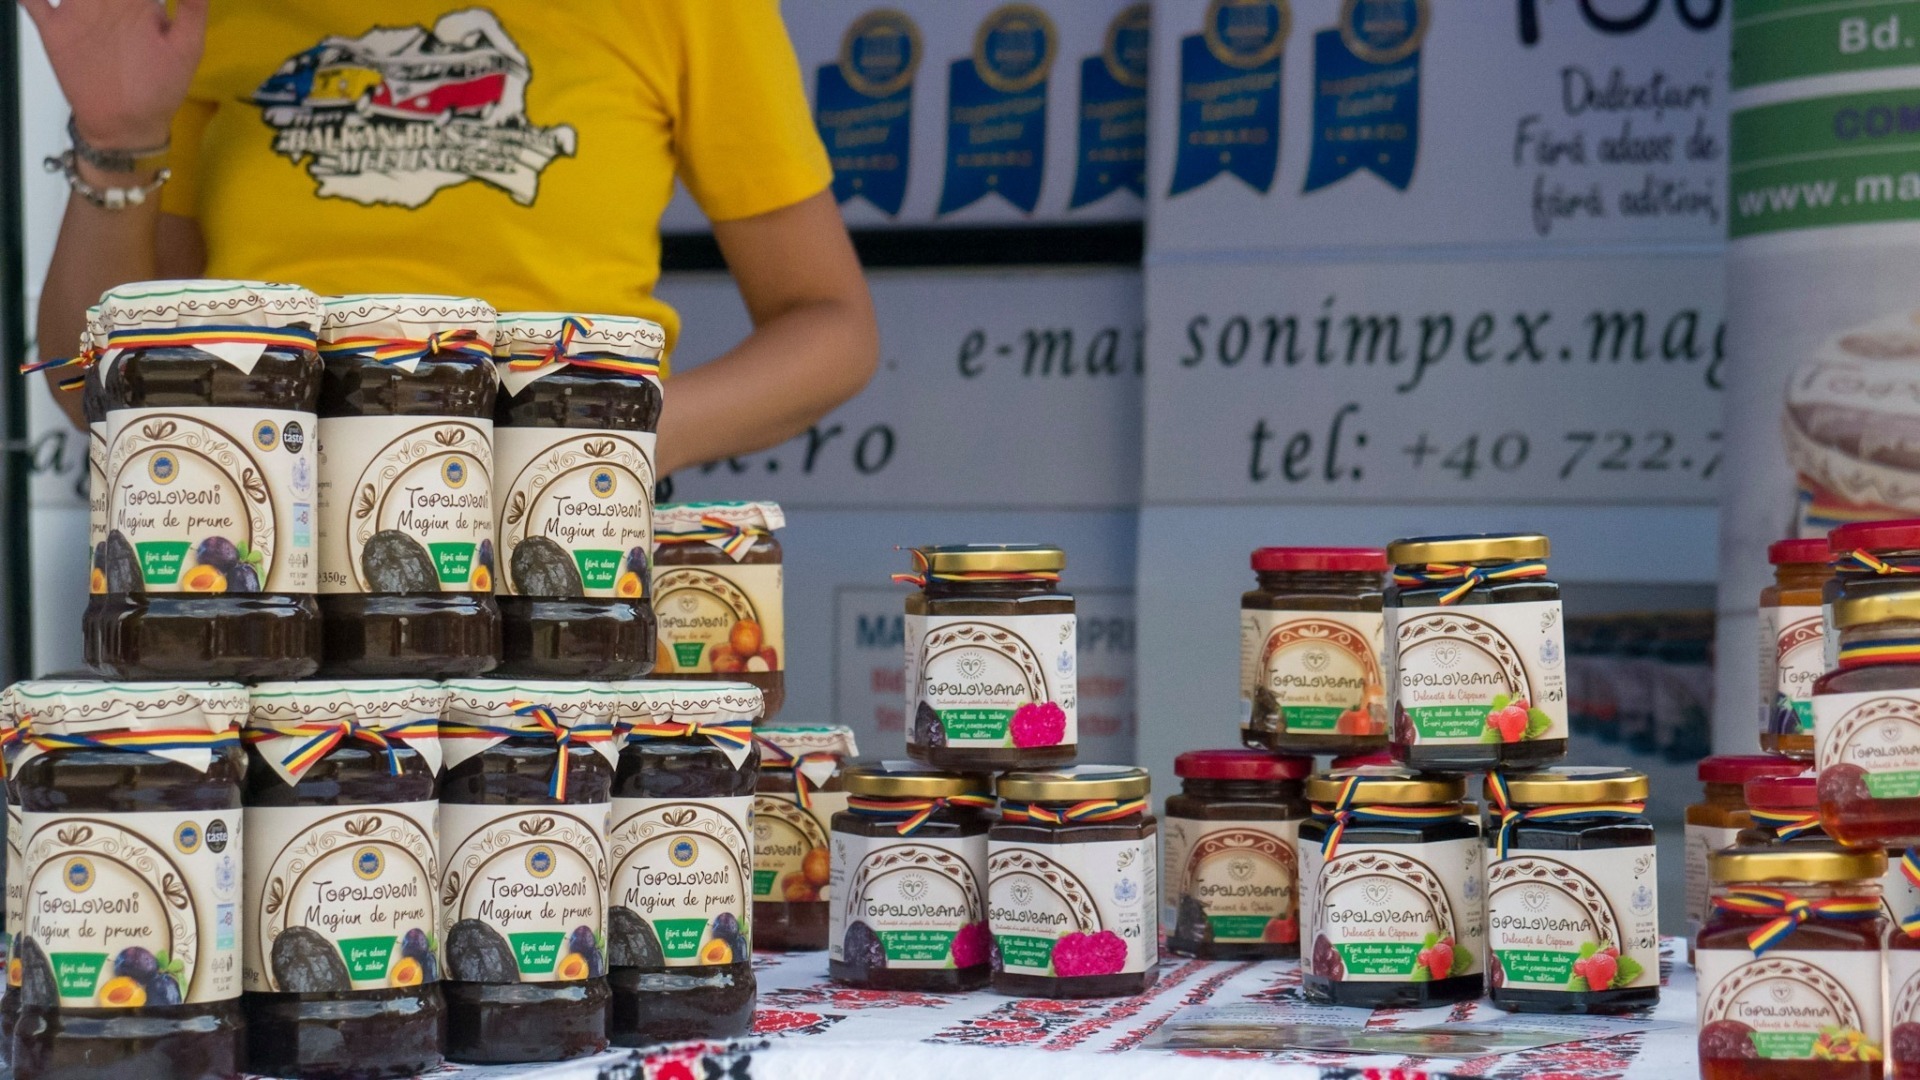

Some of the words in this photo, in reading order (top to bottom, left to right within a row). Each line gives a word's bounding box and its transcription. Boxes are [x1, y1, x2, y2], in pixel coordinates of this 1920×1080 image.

[1838, 17, 1916, 55] Bd.
[405, 124, 463, 147] BUS
[283, 433, 304, 444] taste
[1247, 403, 1368, 483] tel:
[1403, 430, 1531, 480] +40
[117, 509, 155, 536] Magiun
[163, 510, 180, 527] de
[187, 515, 232, 535] prune
[397, 509, 449, 537] Magiun
[456, 511, 469, 531] de
[544, 517, 595, 545] Magiun
[602, 520, 616, 539] de
[621, 527, 646, 546] prune
[207, 832, 228, 842] taste
[478, 899, 532, 927] Magiun
[539, 901, 557, 919] de
[562, 905, 593, 925] prune
[624, 887, 675, 913] Magiun
[683, 888, 699, 906] de
[705, 893, 736, 912] prune
[31, 917, 71, 949] Magiun
[78, 917, 96, 938] de
[104, 924, 153, 946] prune
[304, 905, 362, 933] Magiun
[370, 905, 387, 923] de
[393, 907, 425, 929] prune
